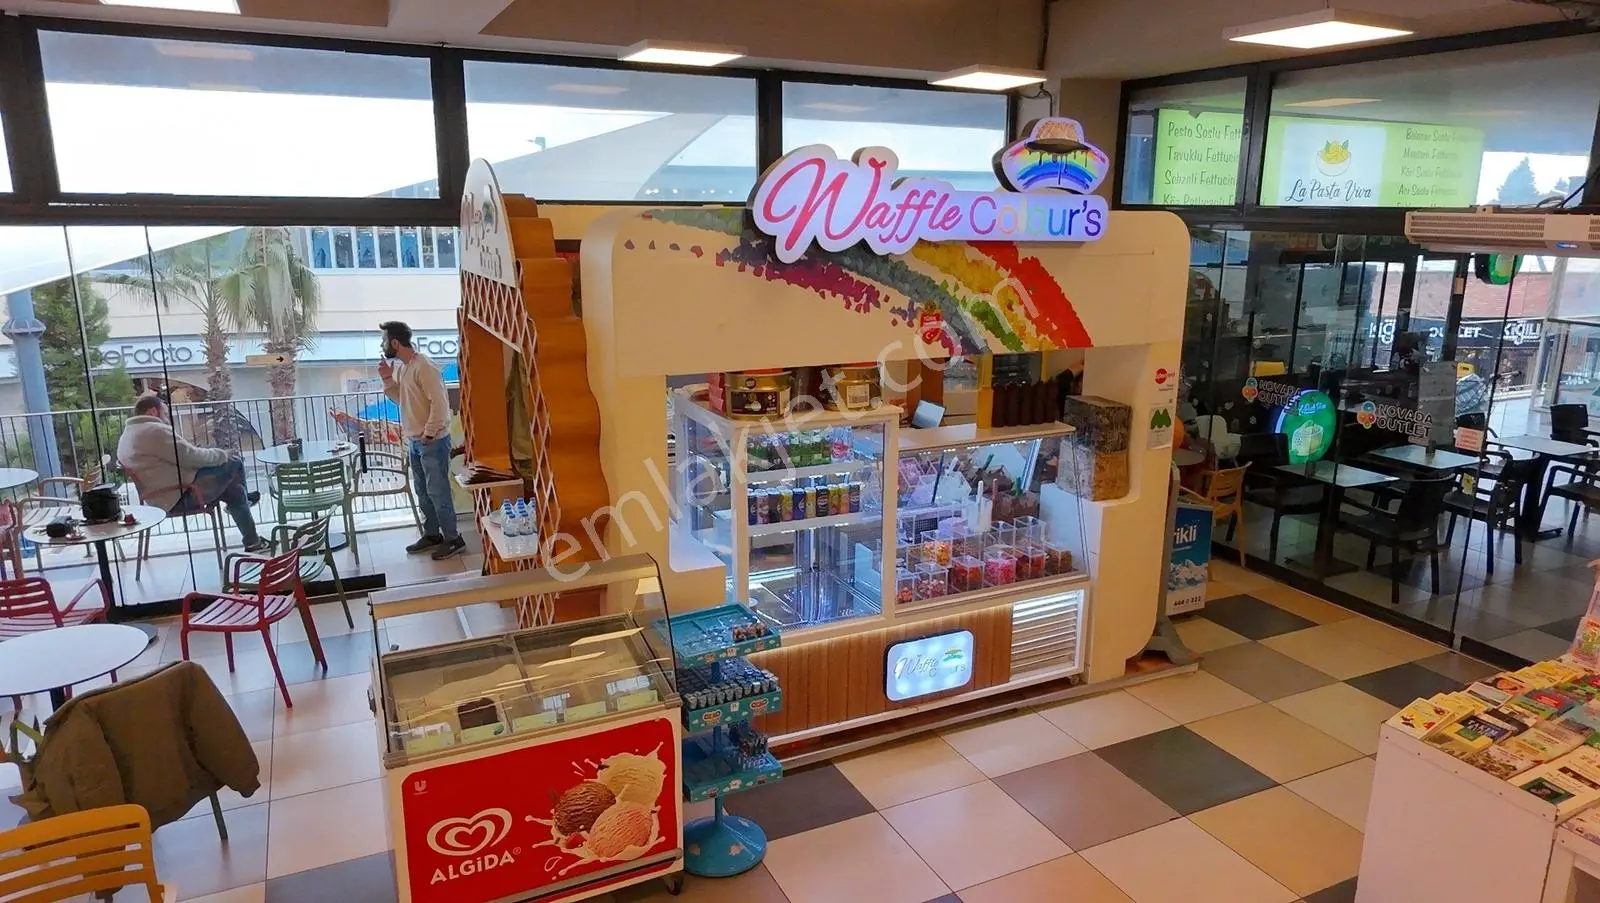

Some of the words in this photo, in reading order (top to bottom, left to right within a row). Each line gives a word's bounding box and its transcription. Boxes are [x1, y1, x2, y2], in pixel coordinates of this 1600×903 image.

[1168, 121, 1192, 137] Pesto
[1195, 123, 1220, 139] Soslu
[1224, 125, 1241, 140] Fett
[1167, 145, 1202, 162] Tavuklu
[1164, 169, 1197, 185] Sebzeli
[1163, 193, 1179, 205] Kö
[1286, 179, 1306, 202] La
[1309, 178, 1341, 201] Pasta
[1343, 179, 1373, 202] Viva
[763, 157, 963, 251] Waffle
[969, 195, 1102, 237] Colour's
[101, 343, 193, 366] eFacto
[1259, 379, 1301, 397] NOVADA
[1379, 403, 1433, 426] NOVADA
[1376, 417, 1432, 438] OUTLET
[1174, 525, 1197, 545] ikli
[894, 654, 939, 680] Waffle
